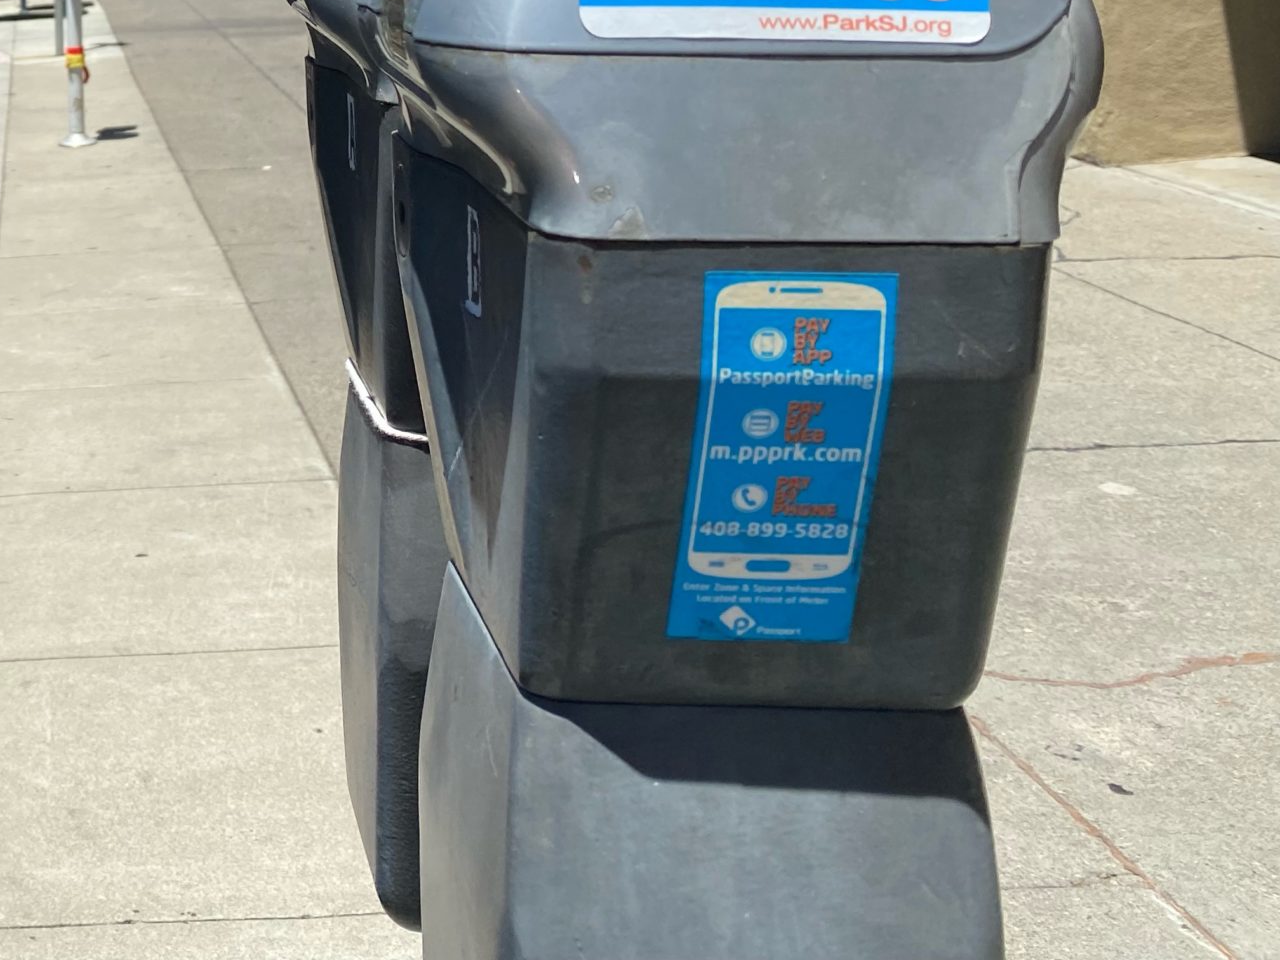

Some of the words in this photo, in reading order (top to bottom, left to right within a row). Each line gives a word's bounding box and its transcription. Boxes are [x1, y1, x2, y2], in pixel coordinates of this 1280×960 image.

[758, 13, 952, 37] www.ParkSJ.org
[794, 317, 831, 332] PAY
[794, 332, 818, 349] BY
[792, 349, 832, 365] APP
[719, 367, 875, 390] PassportParking
[786, 401, 824, 415] PAY
[785, 414, 812, 428] BY
[784, 429, 825, 443] WEB
[709, 443, 862, 464] m.ppprk.com
[776, 476, 812, 489] PAY
[772, 503, 838, 517] PHONE
[699, 521, 849, 539] 408-899-5828
[683, 582, 710, 591] Enter
[713, 583, 739, 592] Zone
[753, 584, 783, 594] Space
[754, 595, 783, 604] Front
